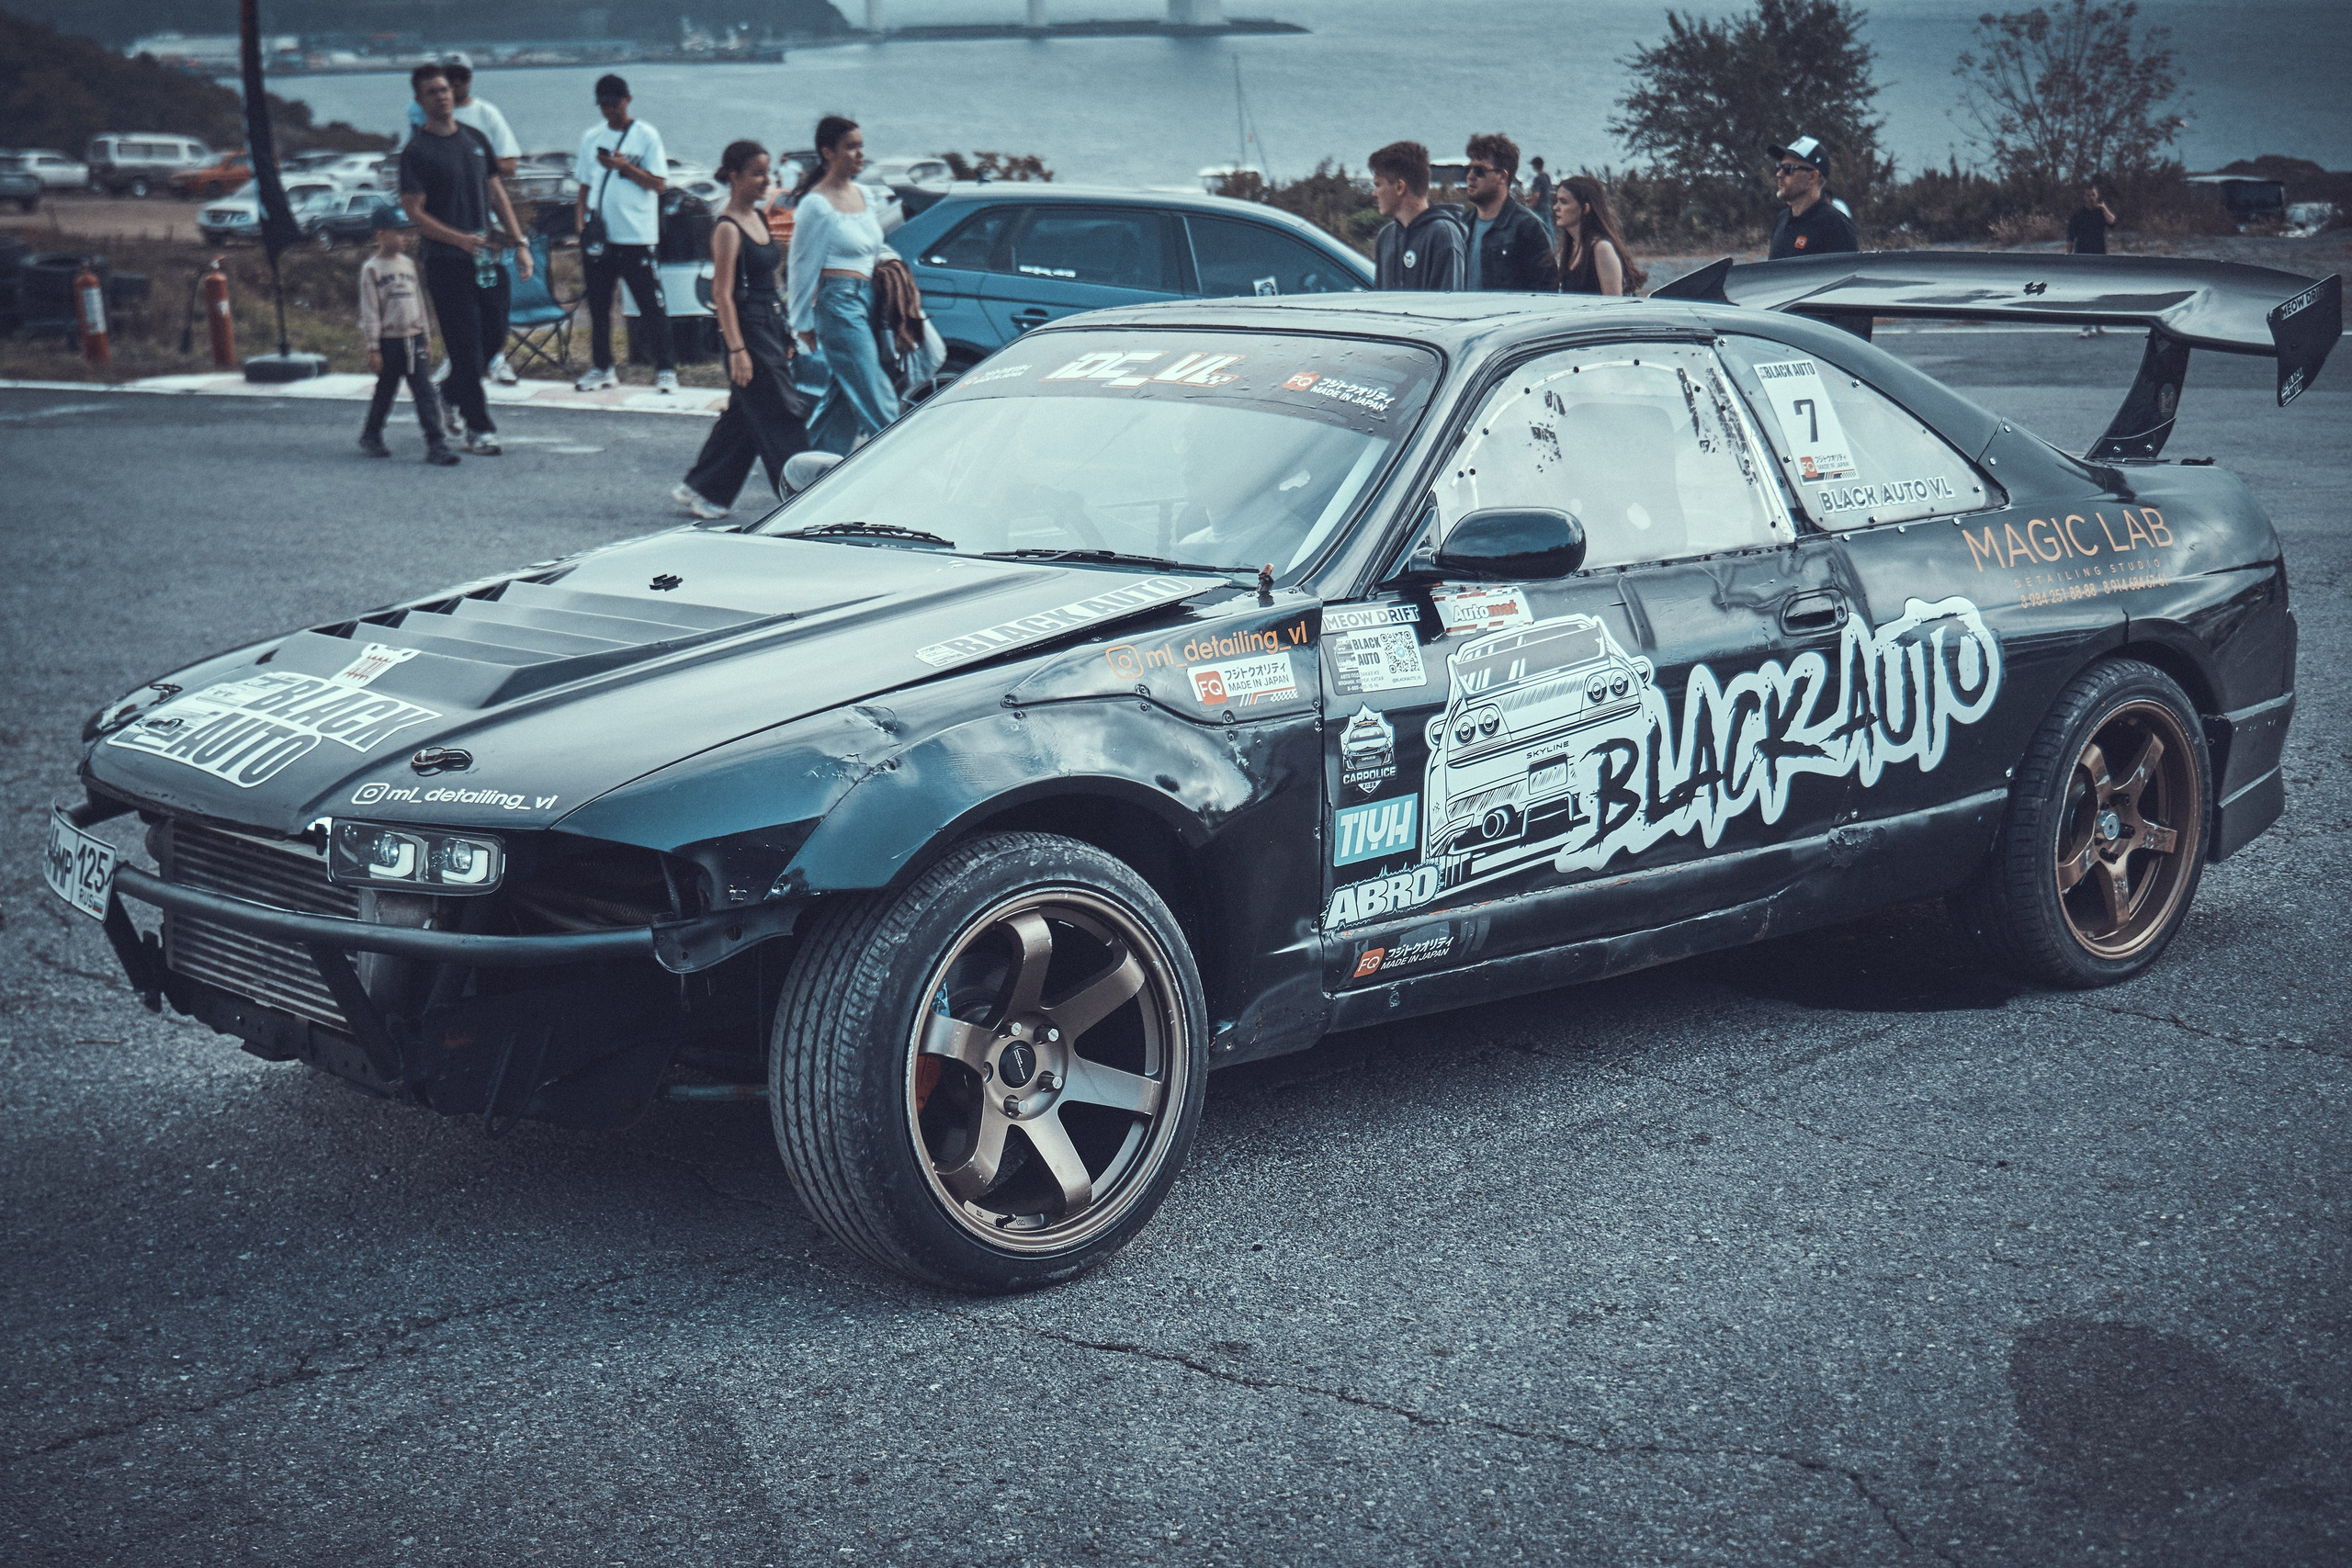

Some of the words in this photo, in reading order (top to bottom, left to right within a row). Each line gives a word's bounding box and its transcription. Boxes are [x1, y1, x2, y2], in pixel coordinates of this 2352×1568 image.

[2280, 295, 2304, 317] MEOW
[1286, 375, 1313, 387] FQ
[1763, 364, 1792, 378] BLACK
[1792, 362, 1815, 377] AUTO
[1310, 386, 1341, 398] MADE
[1339, 392, 1353, 401] IN
[1351, 397, 1388, 412] JAPAN
[1318, 378, 1396, 405] フジトクオリティ
[1792, 399, 1818, 443] 7
[1818, 485, 1879, 512] BLACK
[1881, 479, 1928, 504] AUTO
[1928, 476, 1954, 498] VL
[1962, 513, 2098, 572] MAGIC
[2096, 507, 2174, 553] LAB
[2013, 566, 2102, 589] DETAILING
[2109, 558, 2161, 573] STUDIO
[2020, 594, 2029, 608] 8
[2029, 592, 2049, 607] 984
[2049, 587, 2068, 604] 251
[2069, 582, 2098, 600] 88-88
[2102, 581, 2110, 594] 8
[939, 607, 1086, 656] BLACK
[1079, 576, 1192, 618] AUTO
[1324, 610, 1374, 630] MEOW
[1375, 606, 1419, 625] DRIFT
[1453, 599, 1519, 623] Automat
[1145, 620, 1307, 669] ml_detailing_vl
[1351, 636, 1382, 650] BLACK
[1357, 651, 1381, 666] AUTO
[1225, 662, 1286, 681] フジトクオリティ
[1227, 681, 1253, 692] MADE
[1253, 678, 1263, 688] IN
[1263, 673, 1290, 687] JAPAN
[1197, 680, 1224, 698] FQ
[241, 679, 435, 748] BLACK
[1567, 671, 1837, 855] BLACK
[1819, 612, 1991, 772] AUTO
[164, 711, 318, 785] AUTO
[1526, 740, 1570, 760] SKYLINE
[1342, 766, 1396, 784] CARPOLICE
[386, 786, 559, 810] ml_detailing_vl
[77, 843, 109, 894] 125
[78, 887, 95, 908] RUS
[1324, 865, 1440, 930] ABRO
[1380, 959, 1408, 970] MADE
[1408, 955, 1419, 964] IN
[1419, 947, 1450, 962] JAPAN
[1387, 936, 1454, 959] フジトクオリティ
[1357, 956, 1380, 973] FQ
